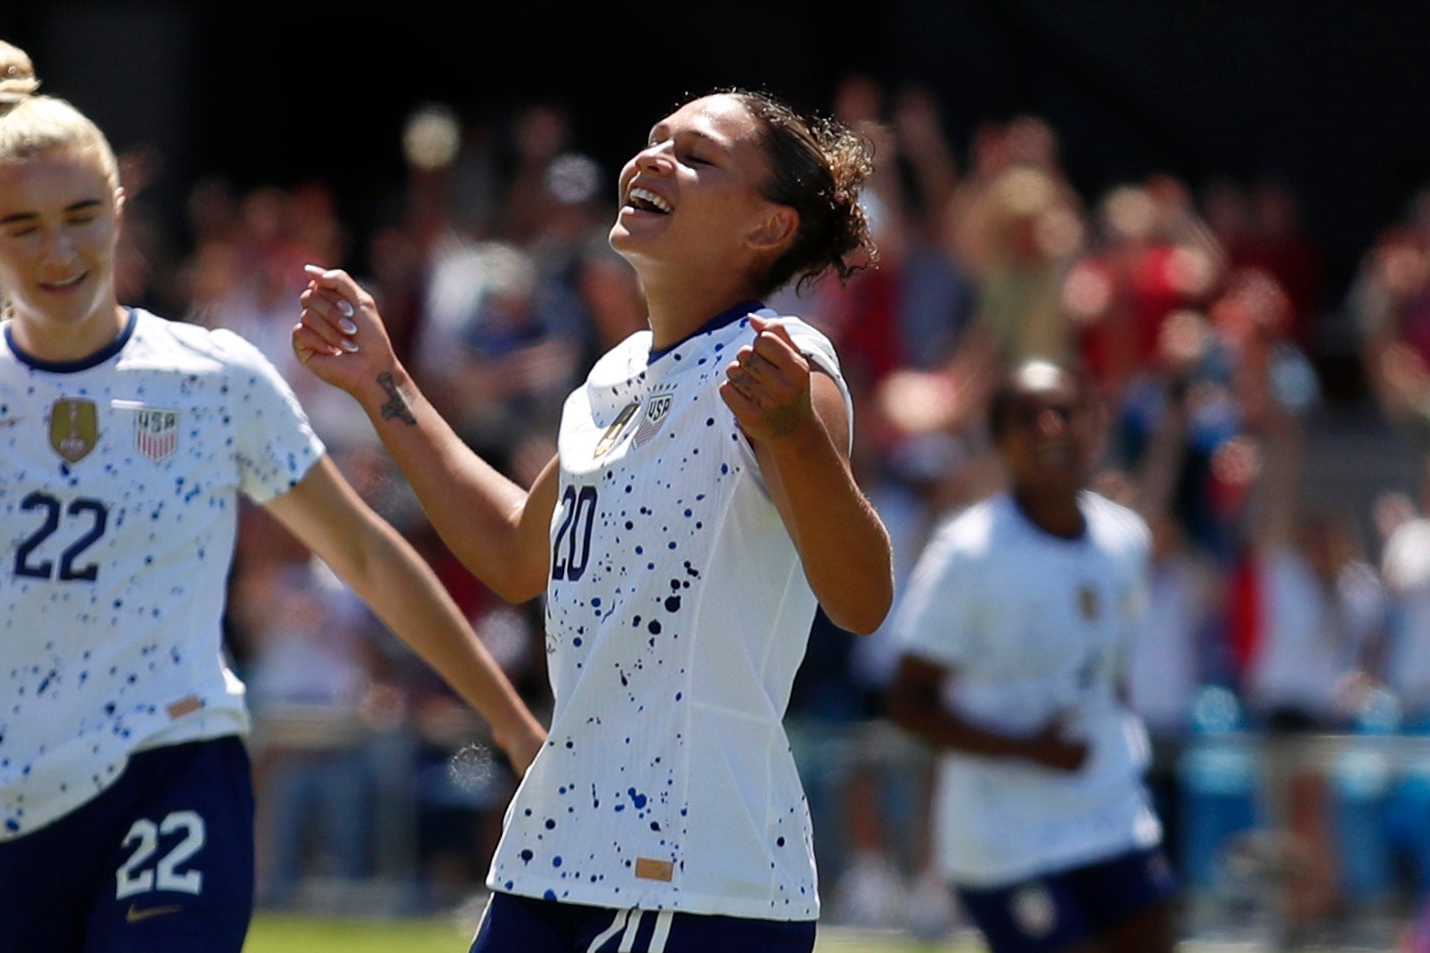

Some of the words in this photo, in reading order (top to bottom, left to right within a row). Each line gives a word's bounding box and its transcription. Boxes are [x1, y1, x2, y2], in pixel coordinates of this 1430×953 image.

[138, 411, 176, 432] USA
[649, 398, 671, 422] USA
[14, 490, 108, 582] 22
[552, 484, 598, 581] 20
[115, 810, 206, 900] 22
